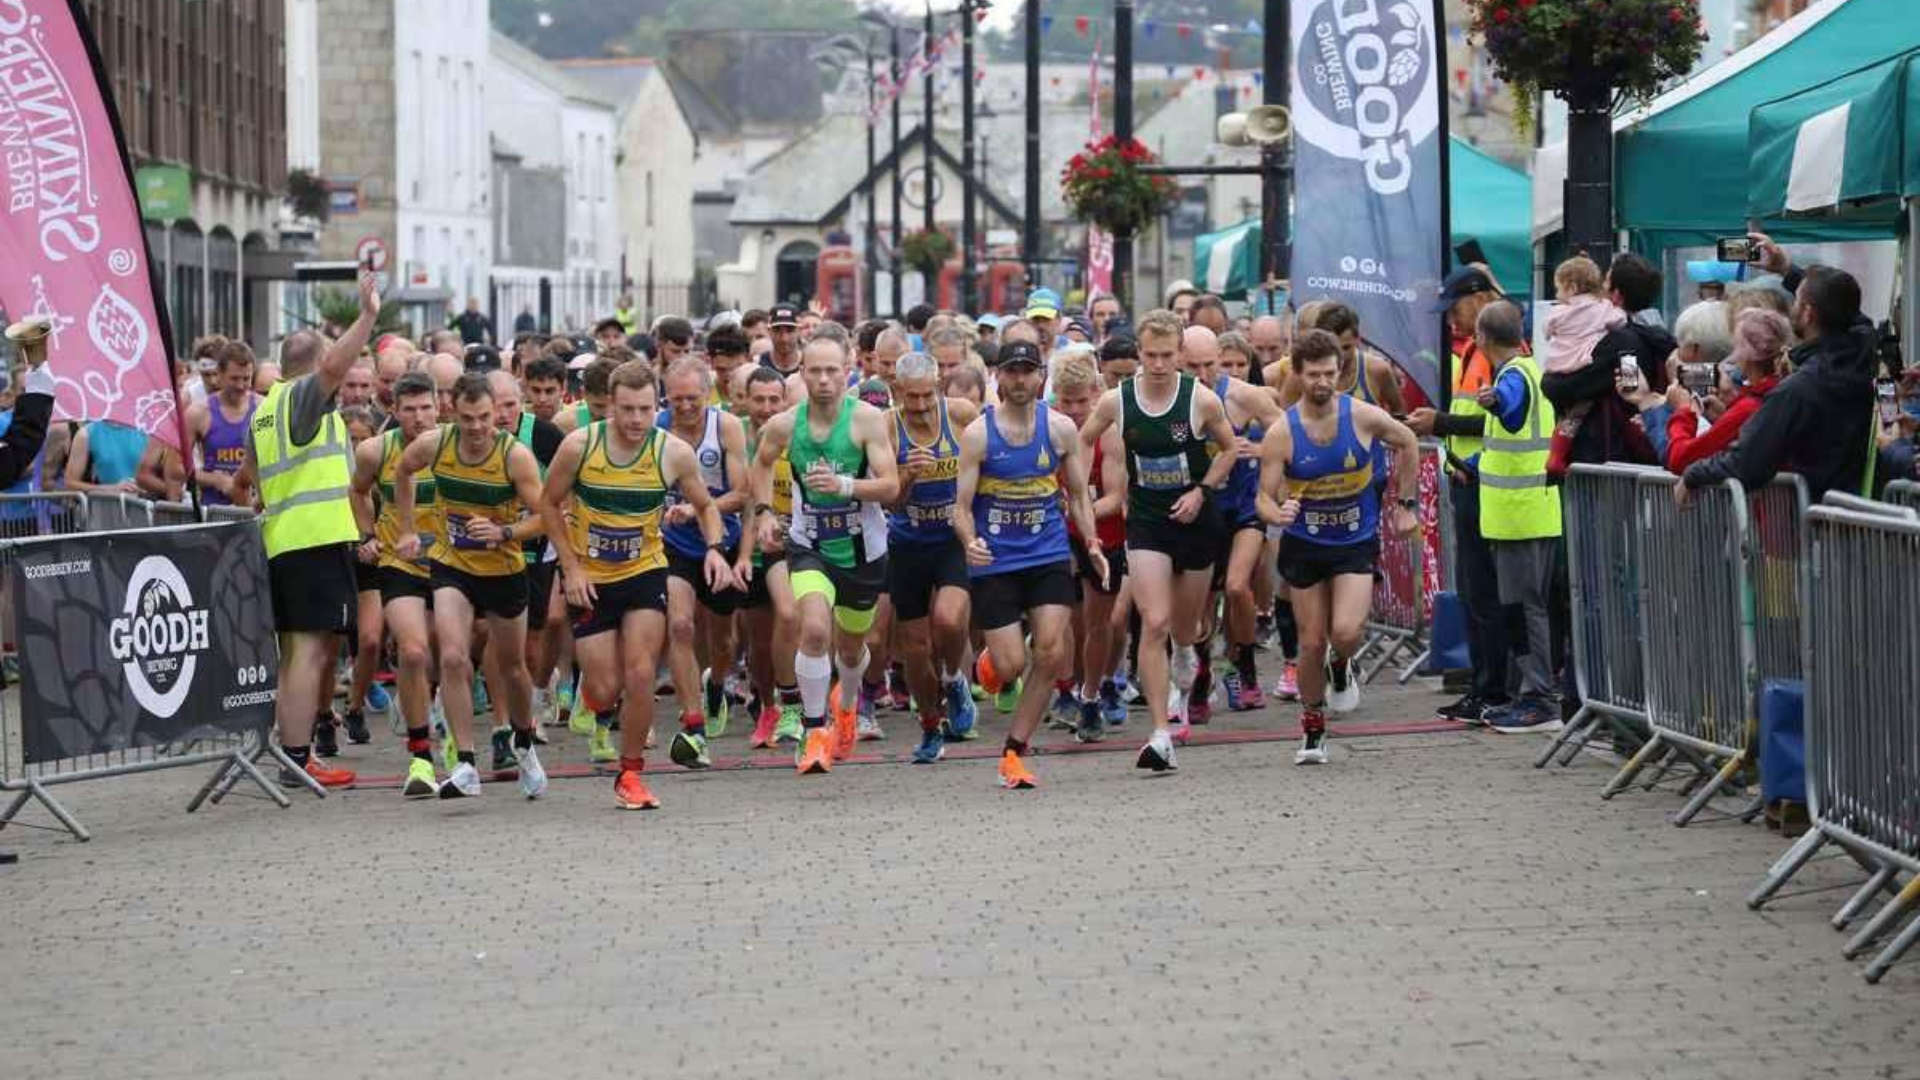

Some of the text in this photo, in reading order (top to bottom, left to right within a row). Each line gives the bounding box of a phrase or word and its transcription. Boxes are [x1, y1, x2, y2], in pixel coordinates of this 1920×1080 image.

[1001, 511, 1032, 526] 312
[600, 537, 629, 553] 211
[109, 609, 210, 660] GOODH
